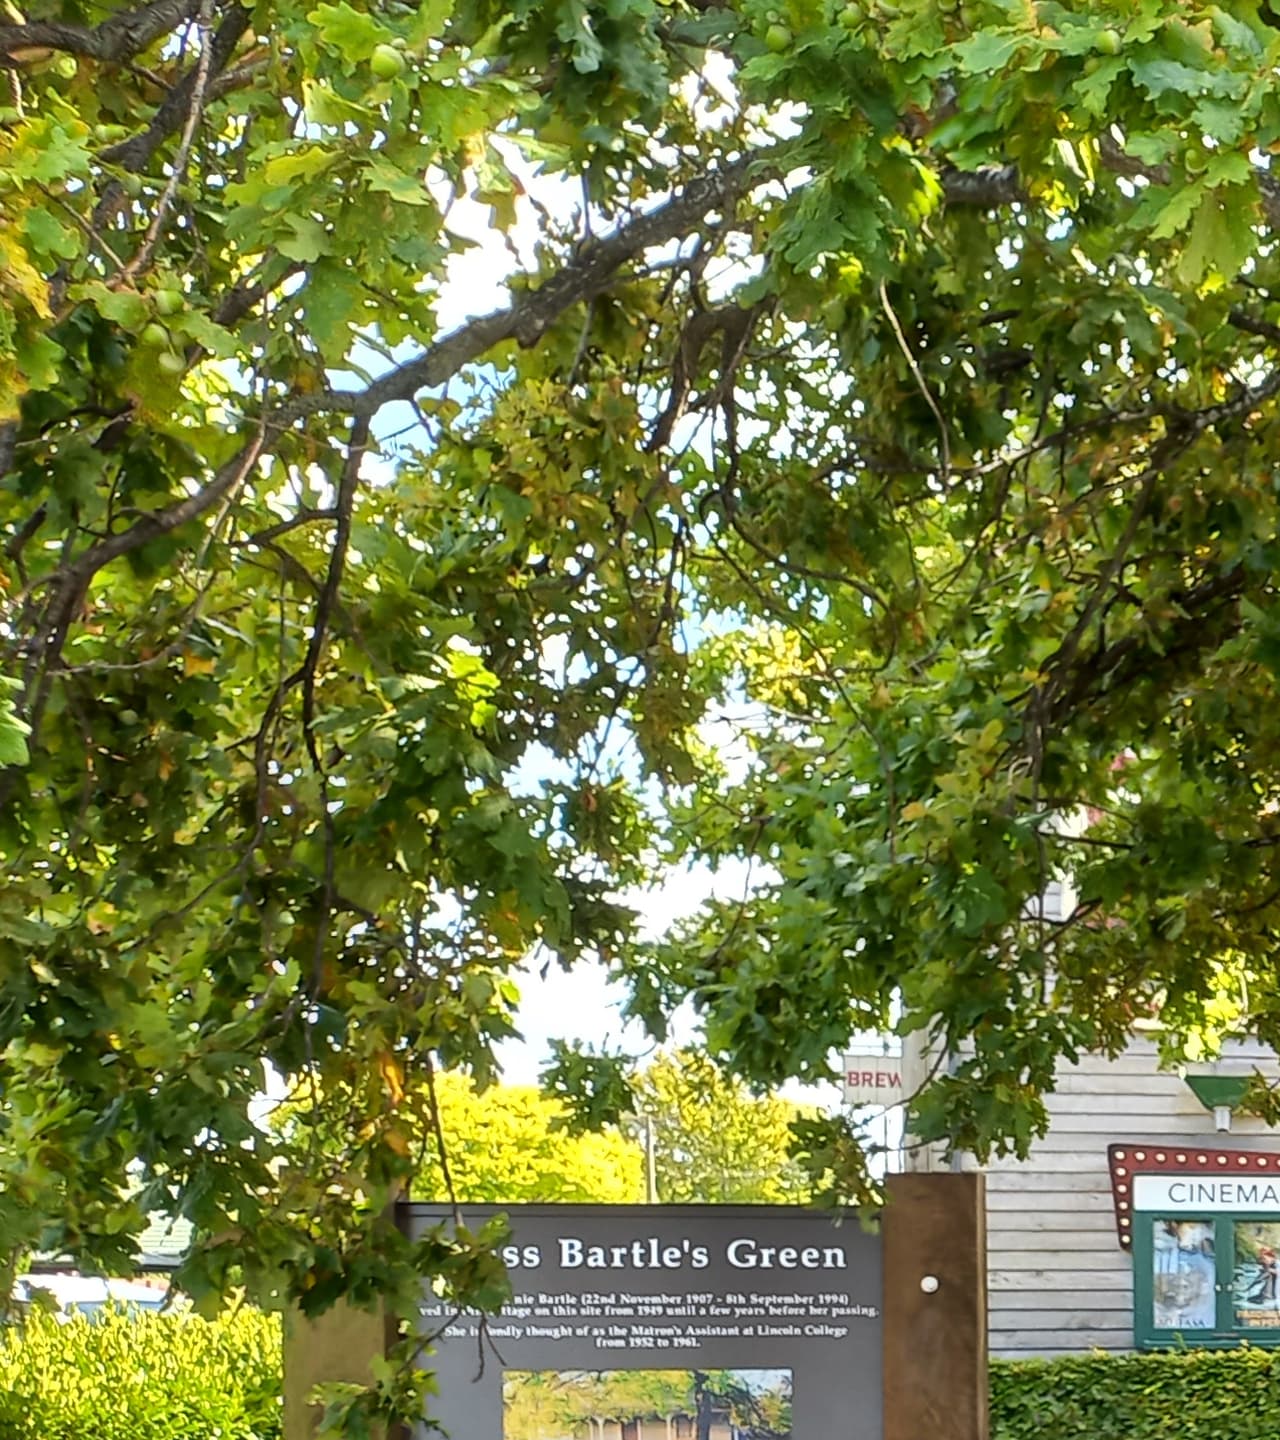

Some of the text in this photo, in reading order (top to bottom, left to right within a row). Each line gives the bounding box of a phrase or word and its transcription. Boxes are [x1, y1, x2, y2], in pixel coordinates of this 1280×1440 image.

[1168, 1183, 1280, 1203] CINEMA
[558, 1238, 709, 1268] Bartle's
[727, 1238, 847, 1268] Green
[538, 1294, 850, 1307] Bartle (22nd November 1907 8th September 1994)
[534, 1305, 880, 1318] on this site from 1949 until a few years before her passing.
[445, 1326, 848, 1338] She thought of as the Matron's Assistant at Lincoln College
[596, 1338, 700, 1348] from 1952 to 1961.
